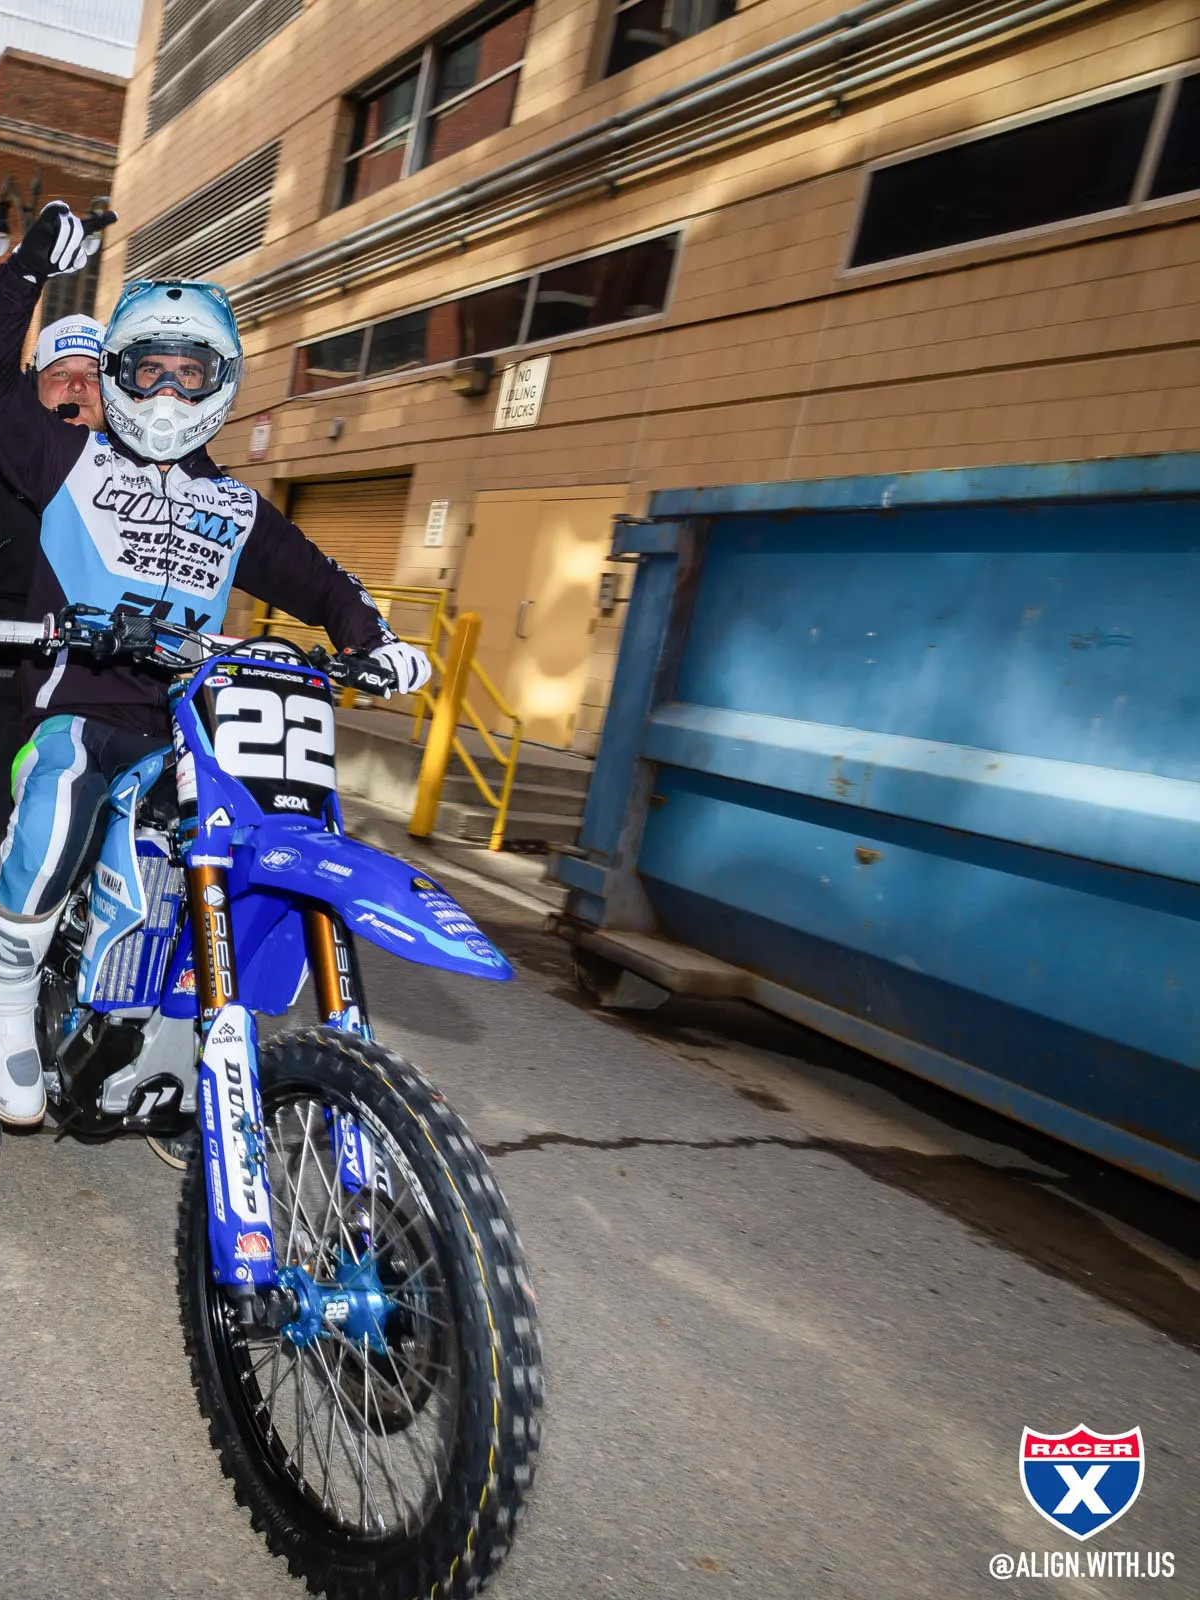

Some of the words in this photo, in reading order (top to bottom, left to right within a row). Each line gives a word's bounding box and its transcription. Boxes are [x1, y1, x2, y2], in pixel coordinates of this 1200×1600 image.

[67, 337, 98, 349] YAMAHA
[519, 368, 531, 382] NO
[505, 385, 536, 402] IDLING
[501, 403, 535, 419] TRUCKS
[117, 549, 221, 590] STUSSY
[242, 667, 304, 683] SUPERCROSS
[358, 672, 388, 687] ASV
[214, 686, 336, 790] 22
[273, 794, 311, 811] SKDA
[101, 869, 122, 896] YAMAHA
[212, 911, 233, 998] REP
[211, 1035, 244, 1045] DUBYA
[325, 1302, 349, 1320] 22
